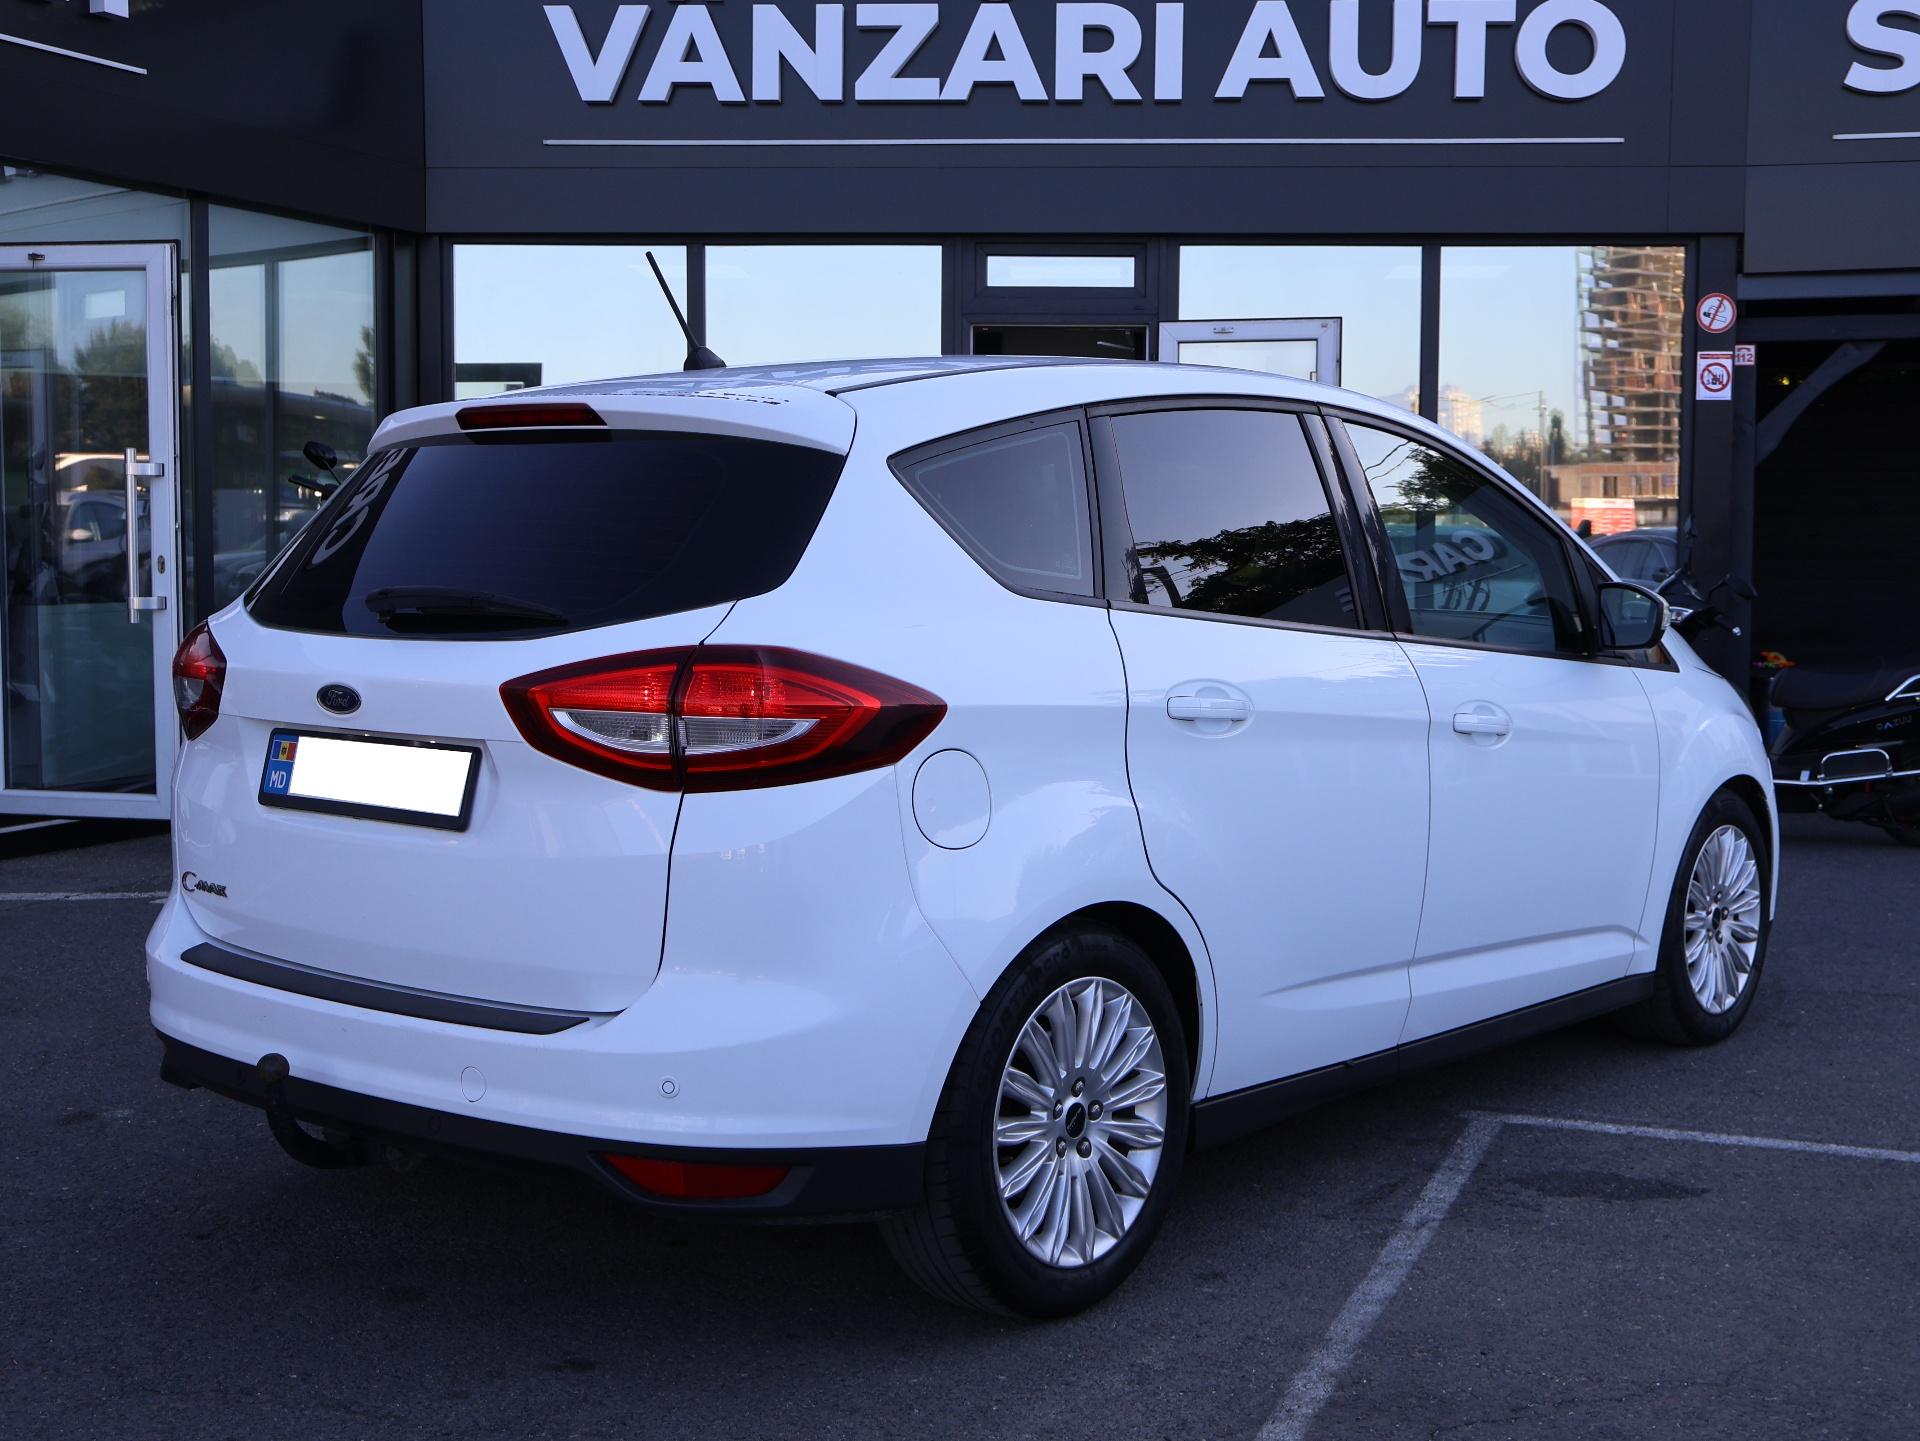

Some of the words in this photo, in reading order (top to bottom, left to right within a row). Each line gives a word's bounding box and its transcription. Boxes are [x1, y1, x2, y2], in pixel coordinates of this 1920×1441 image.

[1213, 0, 1628, 101] AUTO
[1735, 352, 1754, 363] 112
[269, 769, 287, 789] MD
